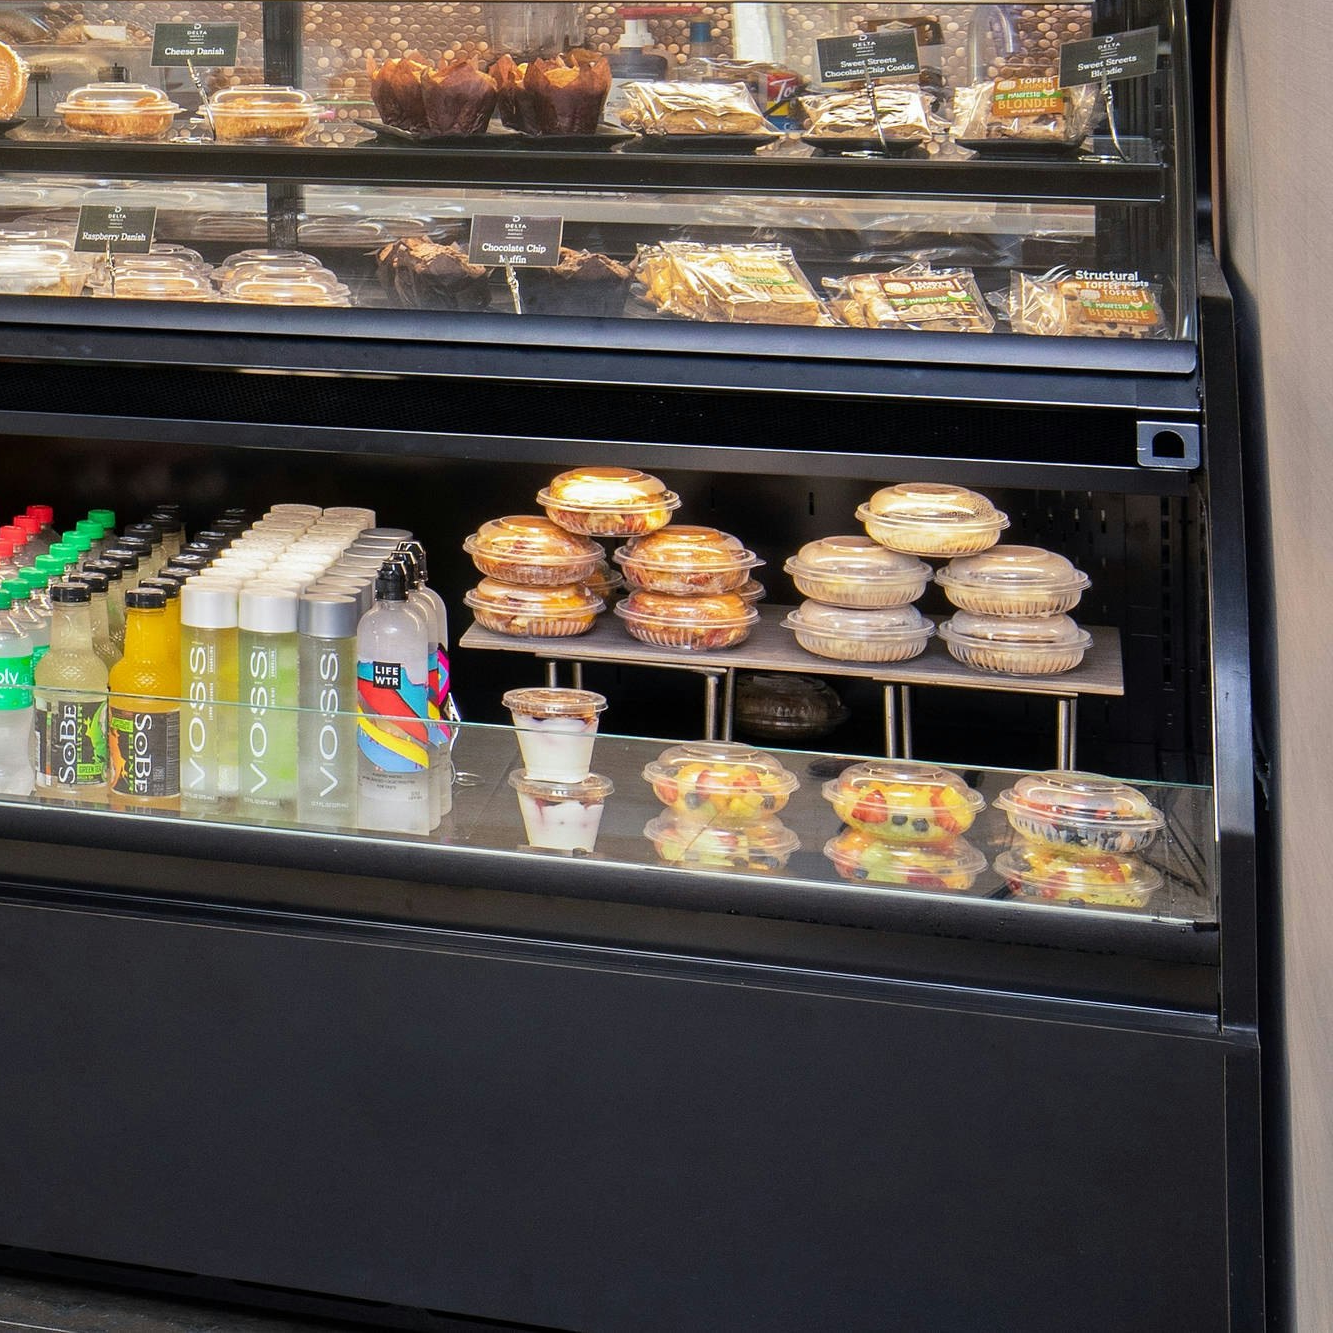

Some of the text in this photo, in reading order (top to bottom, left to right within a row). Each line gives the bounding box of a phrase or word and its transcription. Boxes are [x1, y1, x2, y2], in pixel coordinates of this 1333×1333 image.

[841, 57, 897, 68] Sweet Streets
[1077, 55, 1137, 72] Sweet Streets
[825, 69, 865, 77] Chocolate
[998, 98, 1057, 109] BLONDIE
[82, 232, 146, 241] Raspberry Danish
[482, 243, 546, 254] Chocolate Chip
[1075, 270, 1138, 281] Structural
[375, 666, 398, 675] LIFE
[375, 676, 398, 686] WTR
[189, 647, 206, 788] VOSS
[250, 651, 268, 793] VOSS
[319, 653, 339, 797] VOSS
